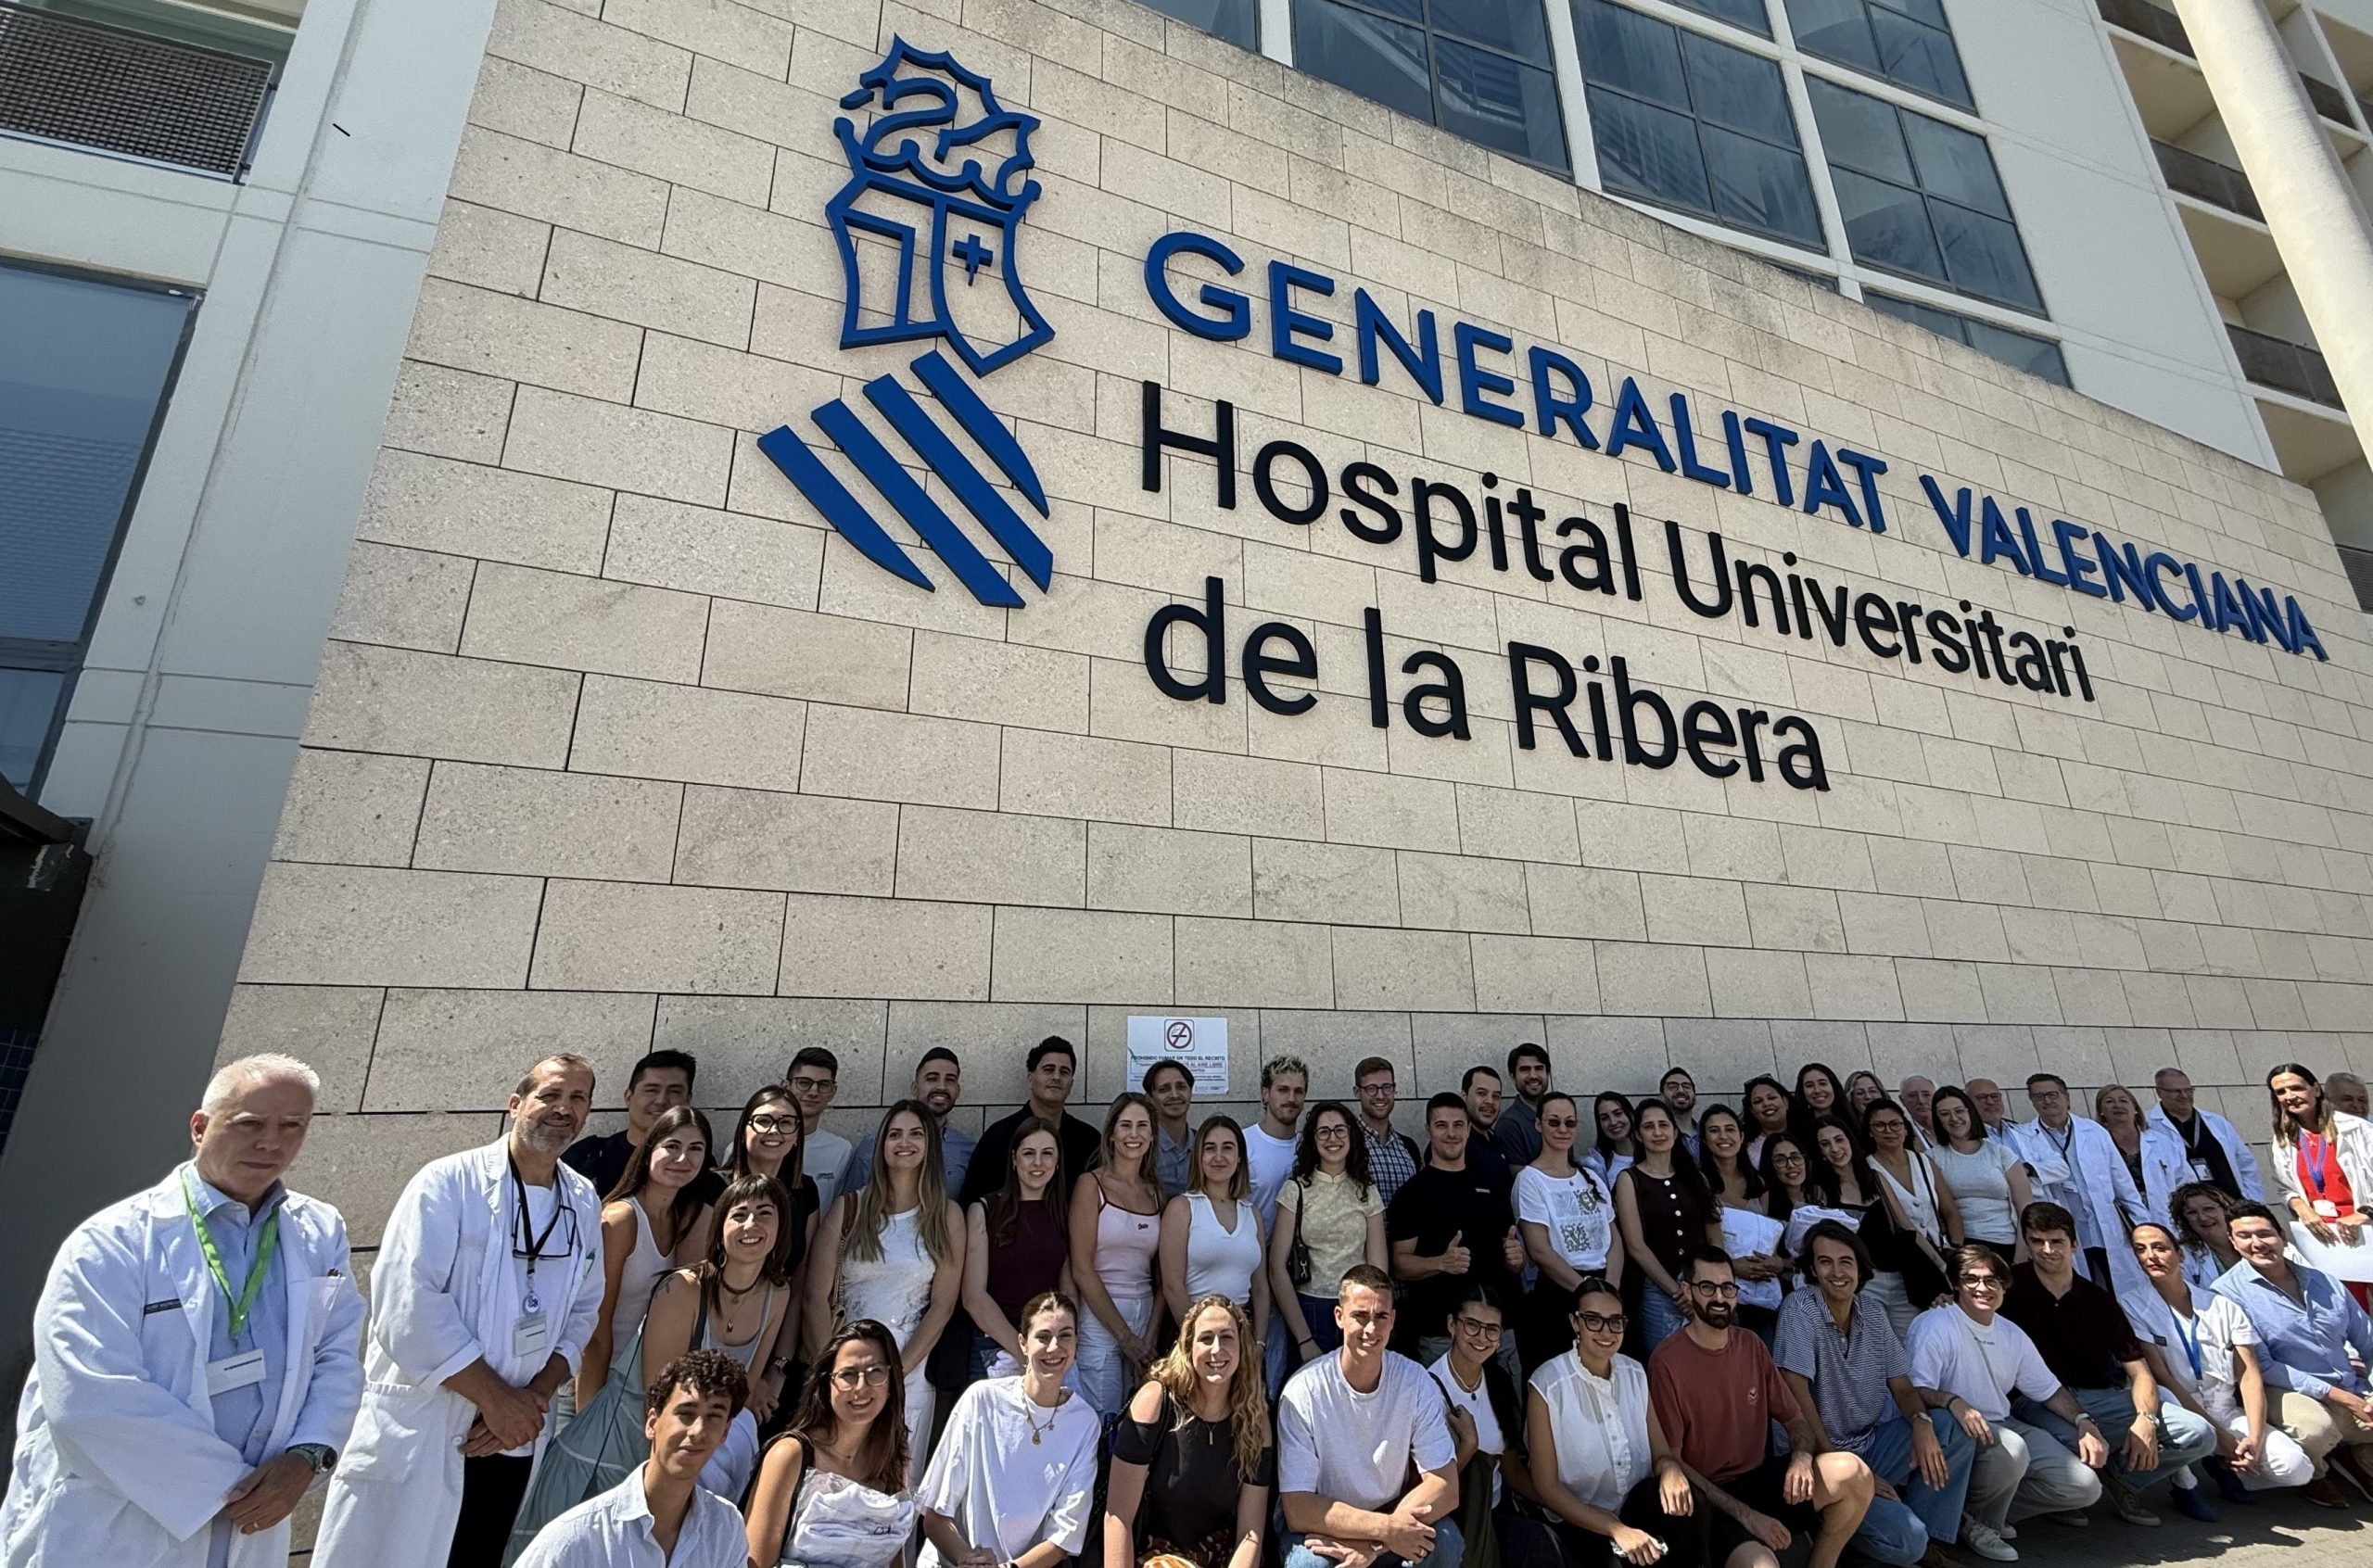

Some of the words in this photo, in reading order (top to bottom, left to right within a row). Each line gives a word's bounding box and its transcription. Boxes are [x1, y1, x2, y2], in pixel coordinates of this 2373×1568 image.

[1142, 380, 1642, 601] Hospital
[1665, 520, 2095, 702] Universitari
[1144, 231, 1886, 534] GENERALITAT
[1919, 474, 2328, 662] VALENCIANA
[1144, 576, 1318, 715] de
[1364, 607, 1471, 740] la
[1508, 641, 1830, 792] Ribera
